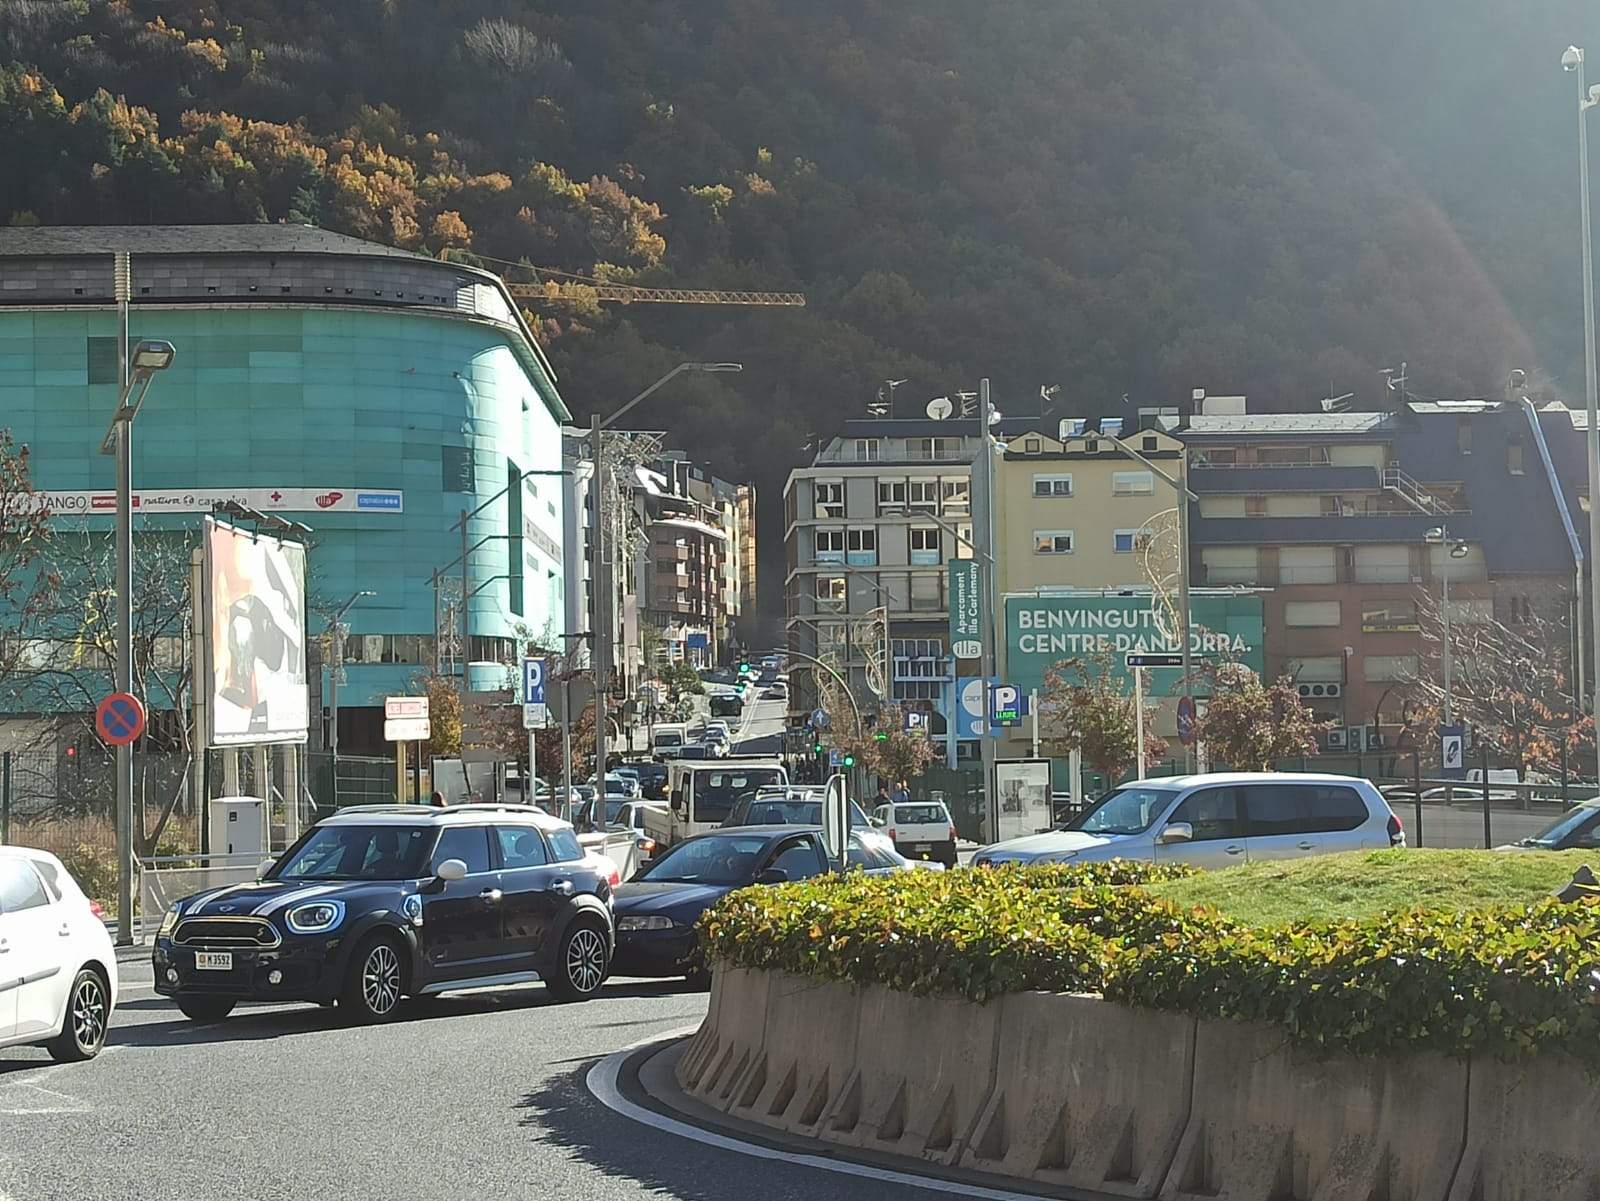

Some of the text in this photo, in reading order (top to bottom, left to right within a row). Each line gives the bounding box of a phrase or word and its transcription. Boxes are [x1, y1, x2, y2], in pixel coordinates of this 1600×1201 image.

[956, 572, 968, 634] Aparcament
[968, 561, 980, 634] illa Carlemany
[956, 641, 978, 655] illa
[1019, 633, 1109, 653] CENTRE
[526, 661, 542, 702] P
[995, 686, 1017, 712] P
